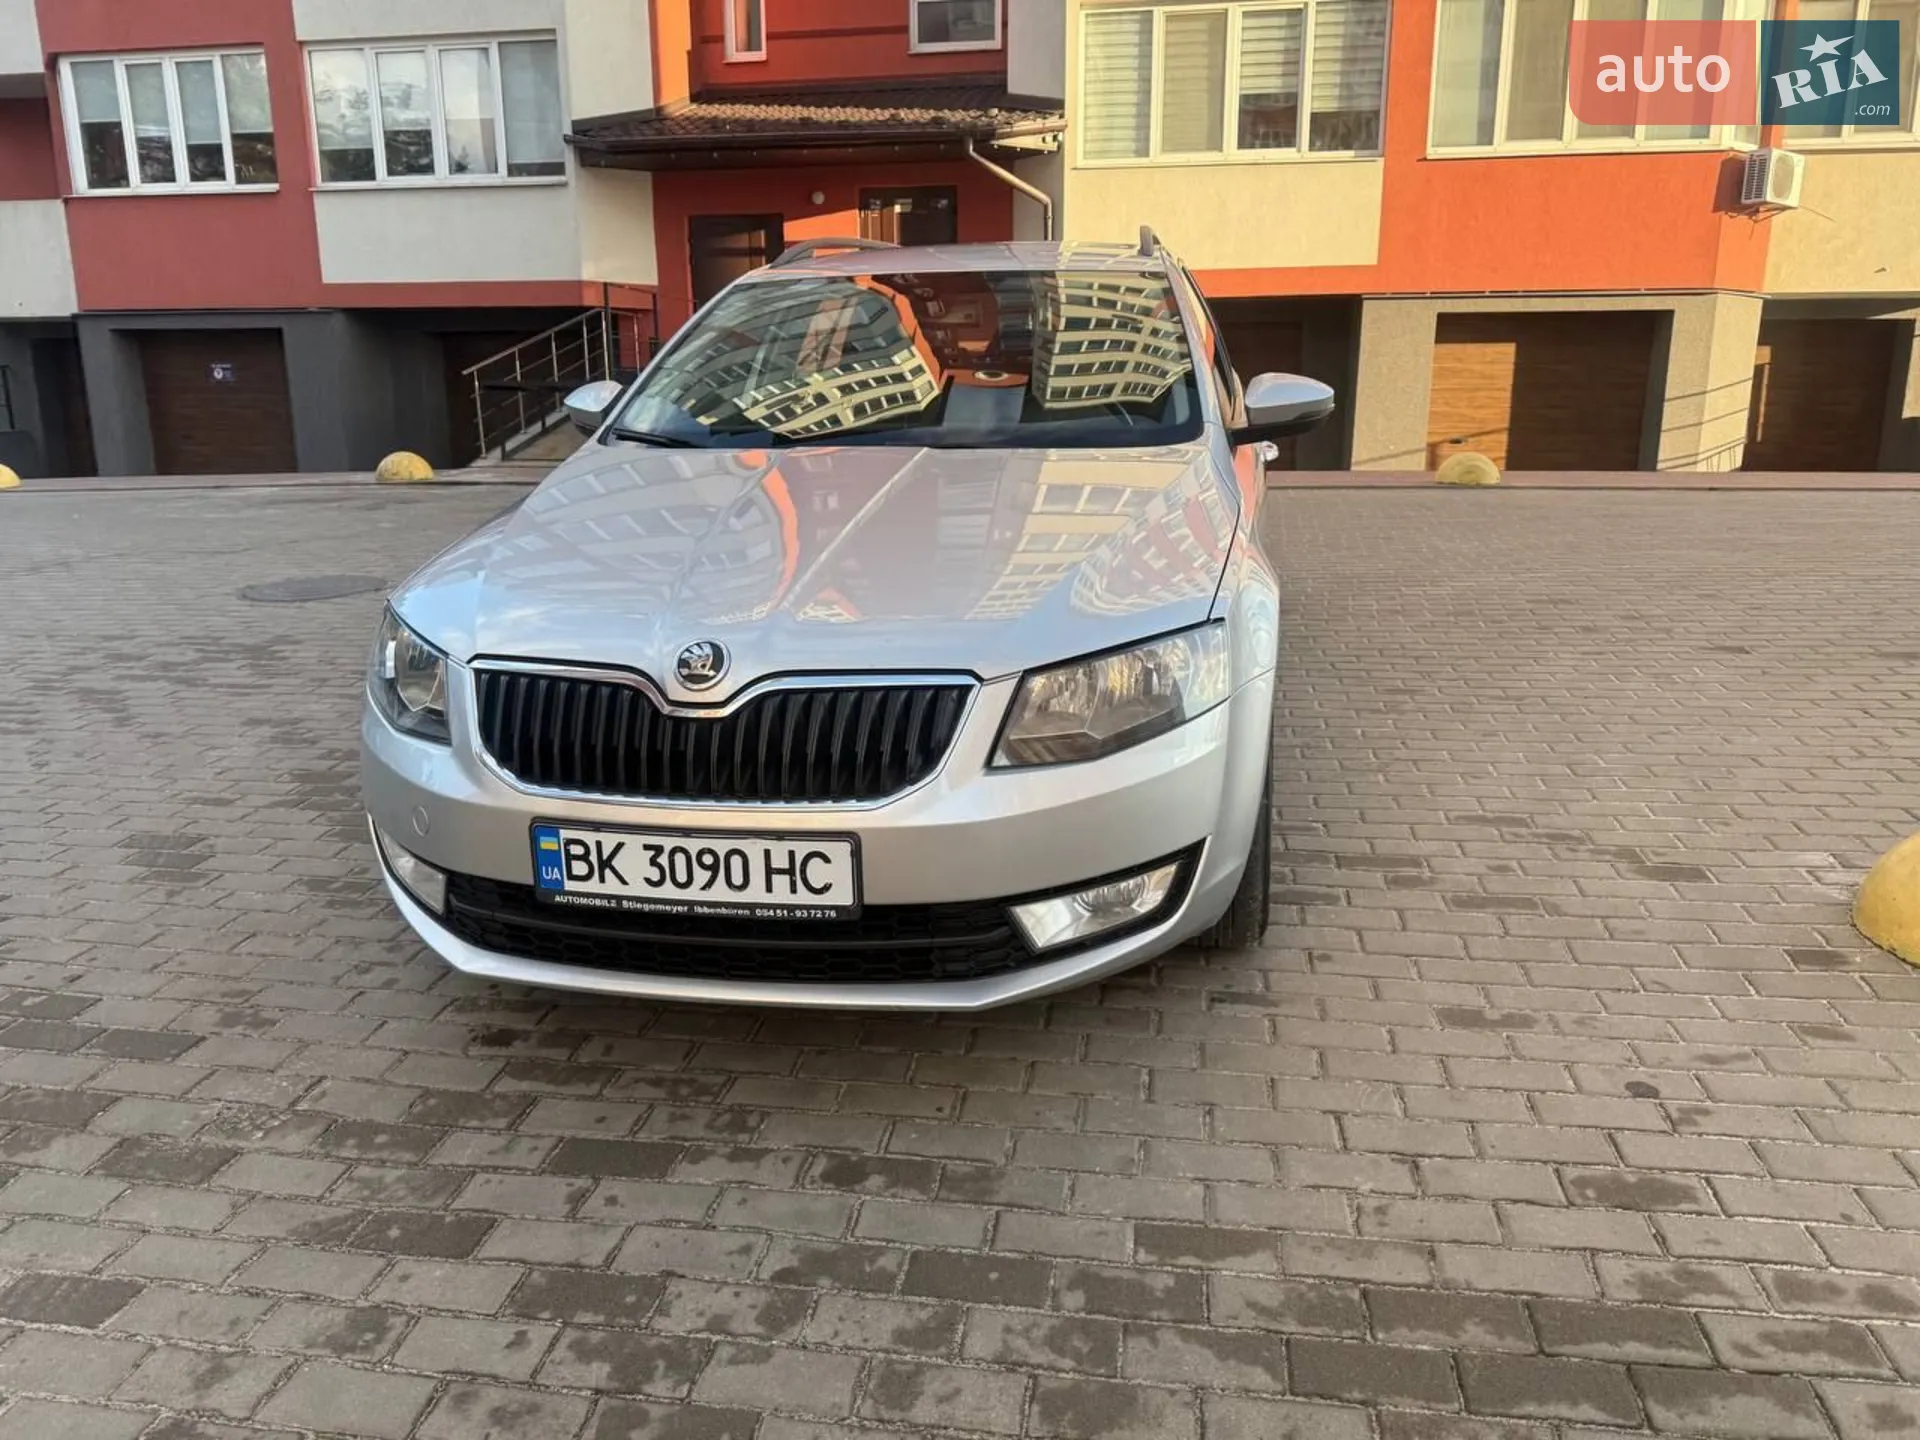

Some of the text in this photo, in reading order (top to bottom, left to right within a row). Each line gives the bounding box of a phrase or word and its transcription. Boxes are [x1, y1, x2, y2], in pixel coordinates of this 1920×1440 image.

[542, 867, 562, 881] UA
[563, 838, 833, 896] BK 3090 HC
